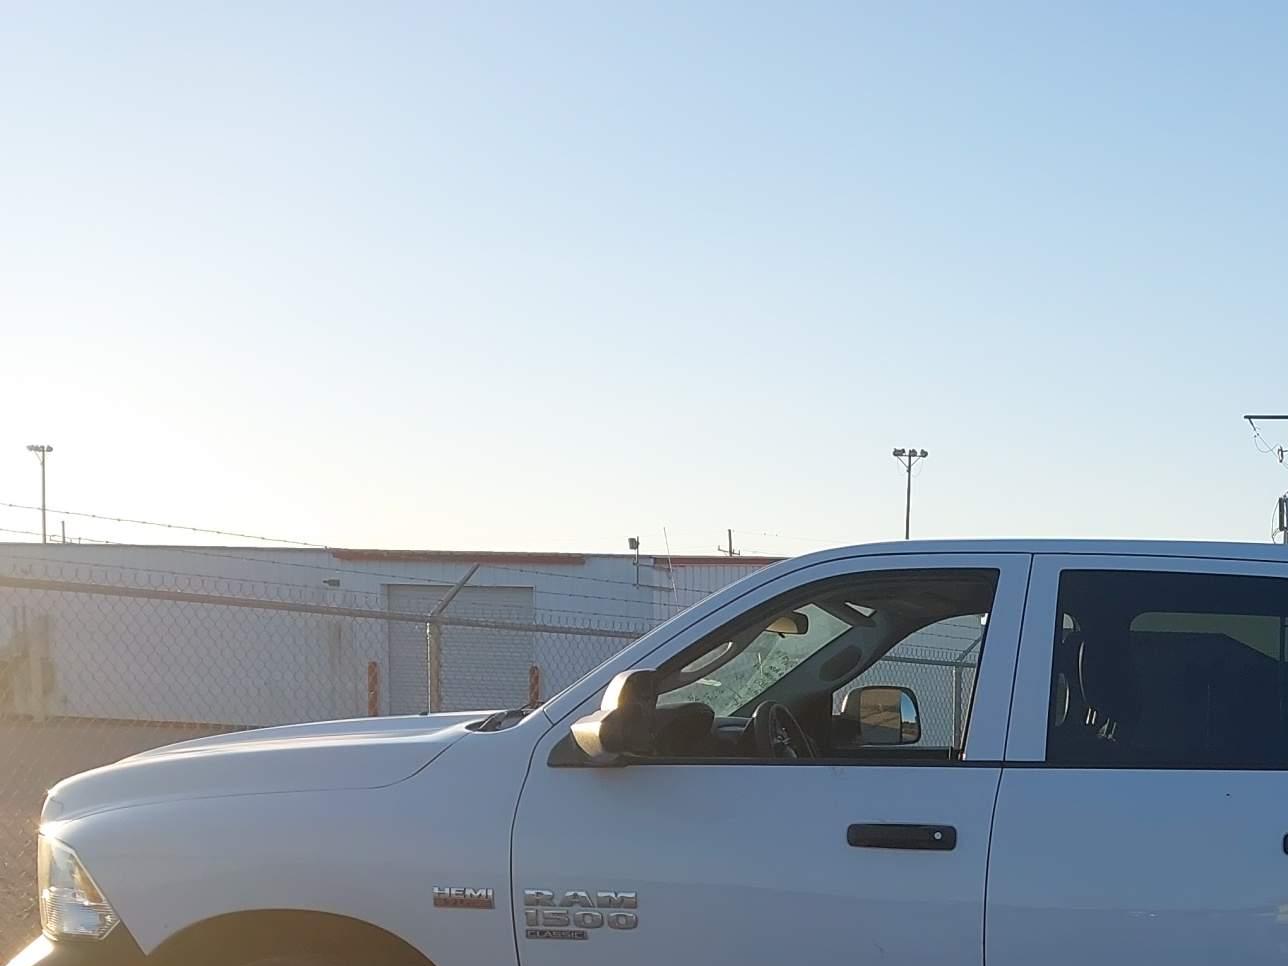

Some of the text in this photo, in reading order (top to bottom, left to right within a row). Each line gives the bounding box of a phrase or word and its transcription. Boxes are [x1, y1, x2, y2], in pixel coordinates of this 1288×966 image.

[432, 887, 494, 899] HEMI
[524, 889, 637, 909] RAM
[525, 909, 638, 930] 1500
[526, 929, 588, 940] CLASSIC
